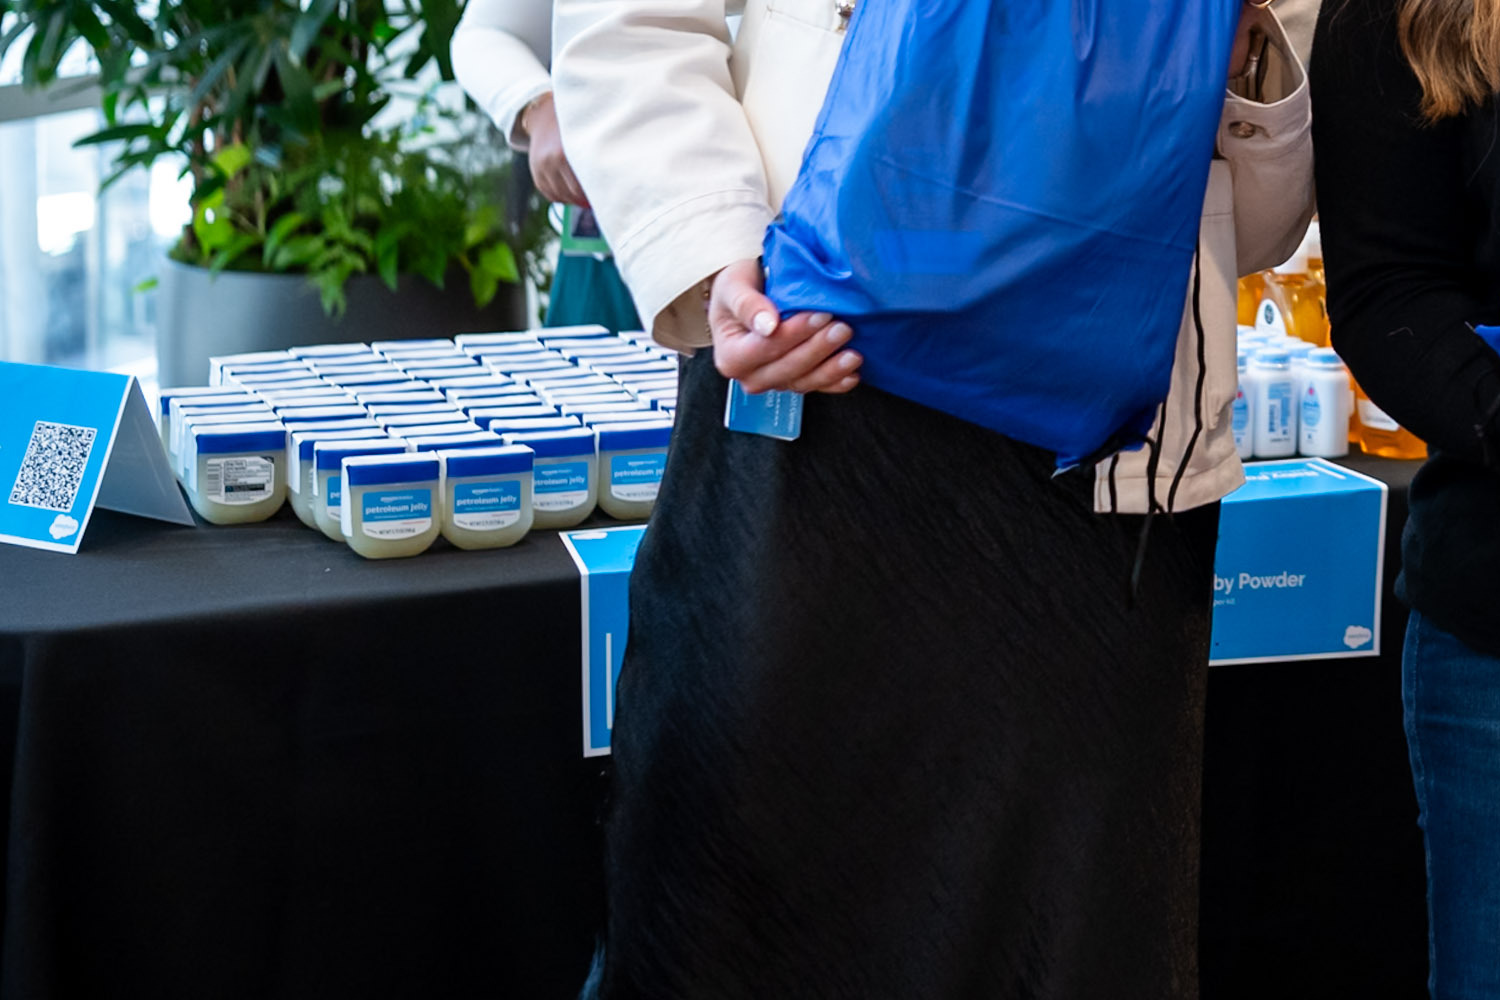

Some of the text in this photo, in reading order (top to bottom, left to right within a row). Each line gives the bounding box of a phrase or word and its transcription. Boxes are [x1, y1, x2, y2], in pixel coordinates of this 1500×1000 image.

[456, 497, 499, 506] petroleum
[365, 502, 428, 515] petroleum jelly
[1238, 571, 1306, 590] Powder
